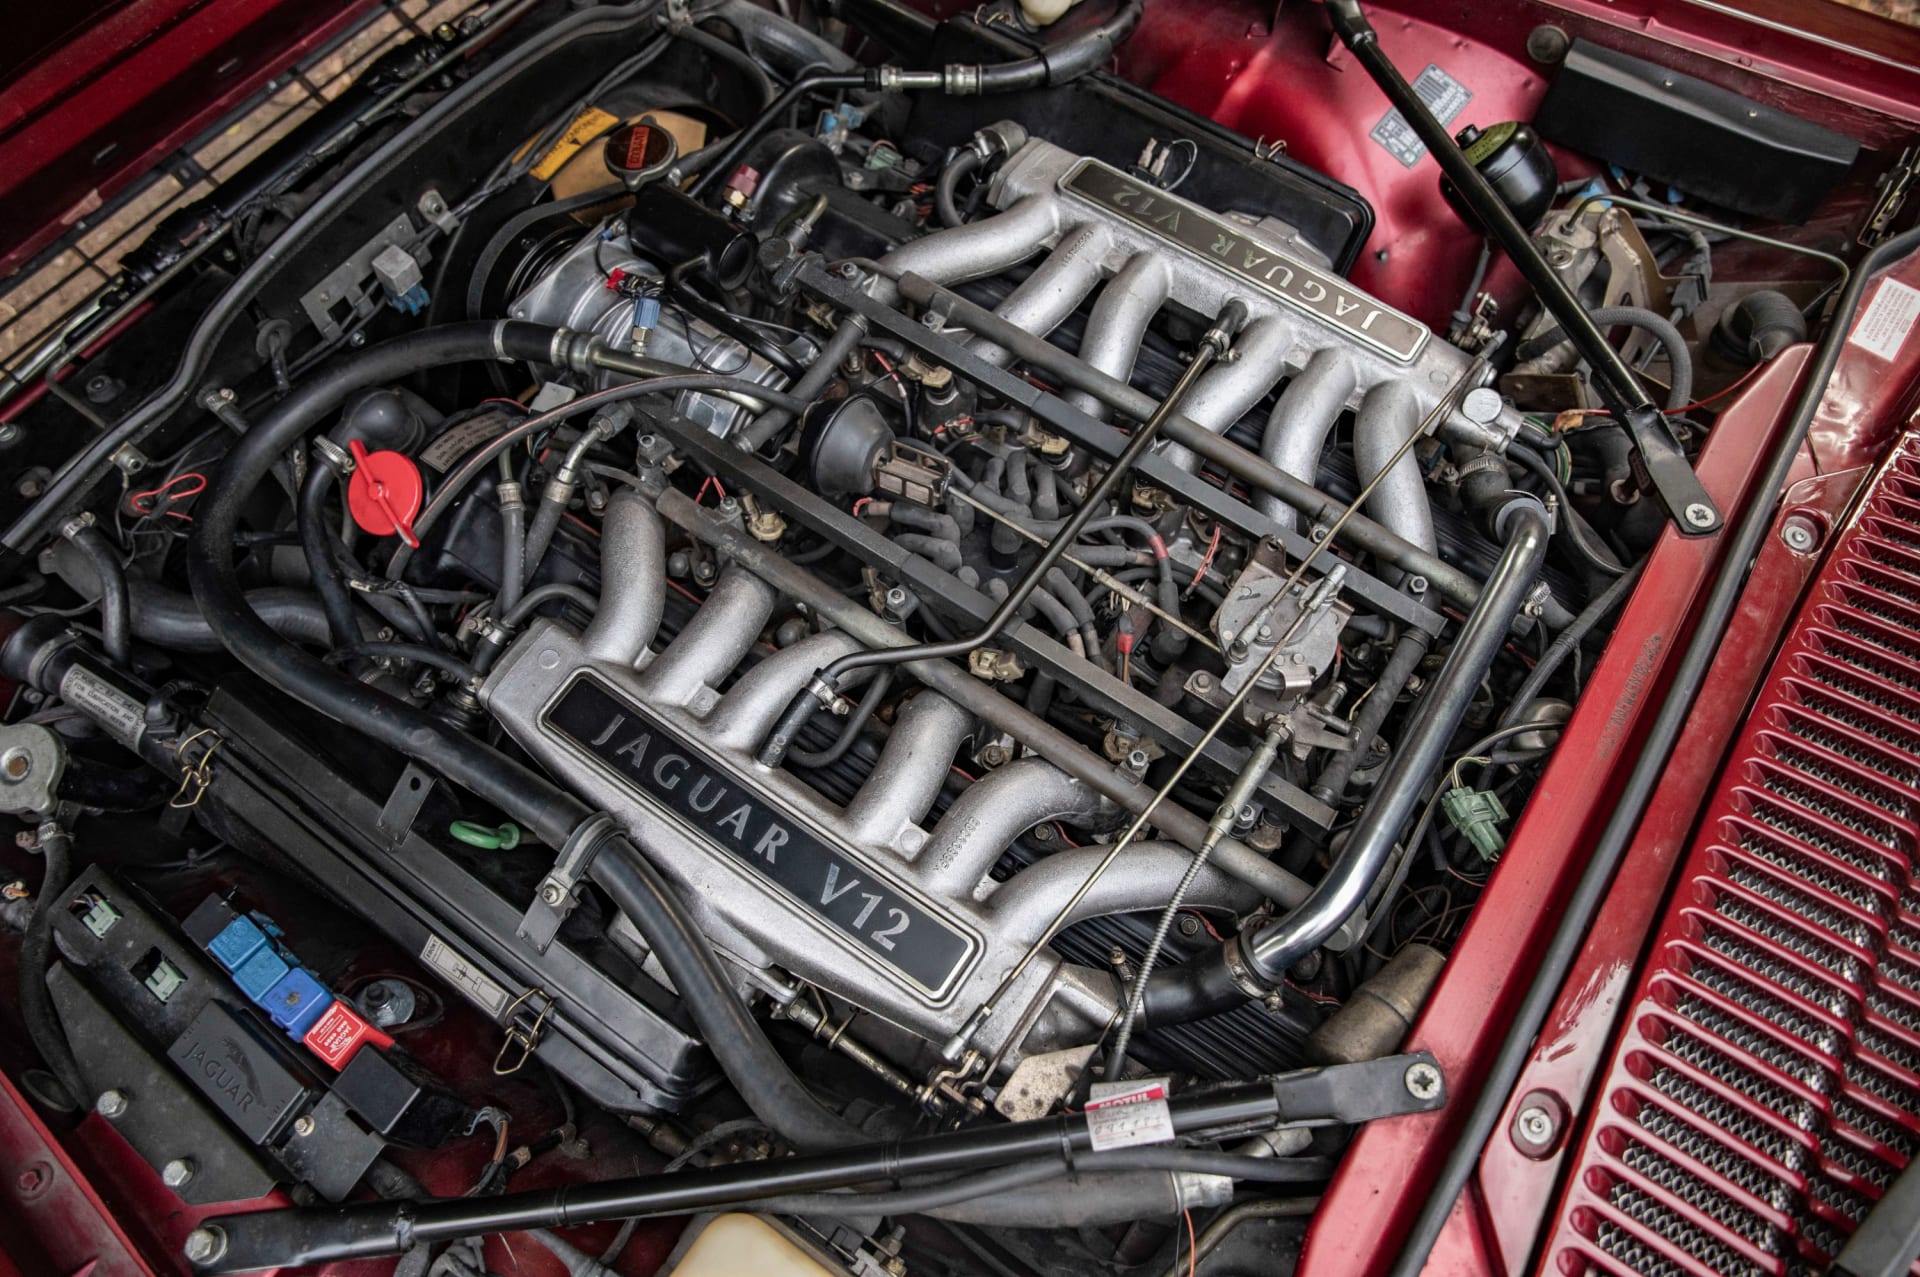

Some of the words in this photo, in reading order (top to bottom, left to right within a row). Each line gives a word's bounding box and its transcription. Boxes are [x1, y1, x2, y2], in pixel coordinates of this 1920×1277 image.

[1112, 185, 1182, 233] V12
[1210, 233, 1382, 331] JAGUAR
[591, 713, 789, 864] JAGUAR
[820, 862, 910, 951] V12
[182, 1042, 254, 1113] JAGUAR
